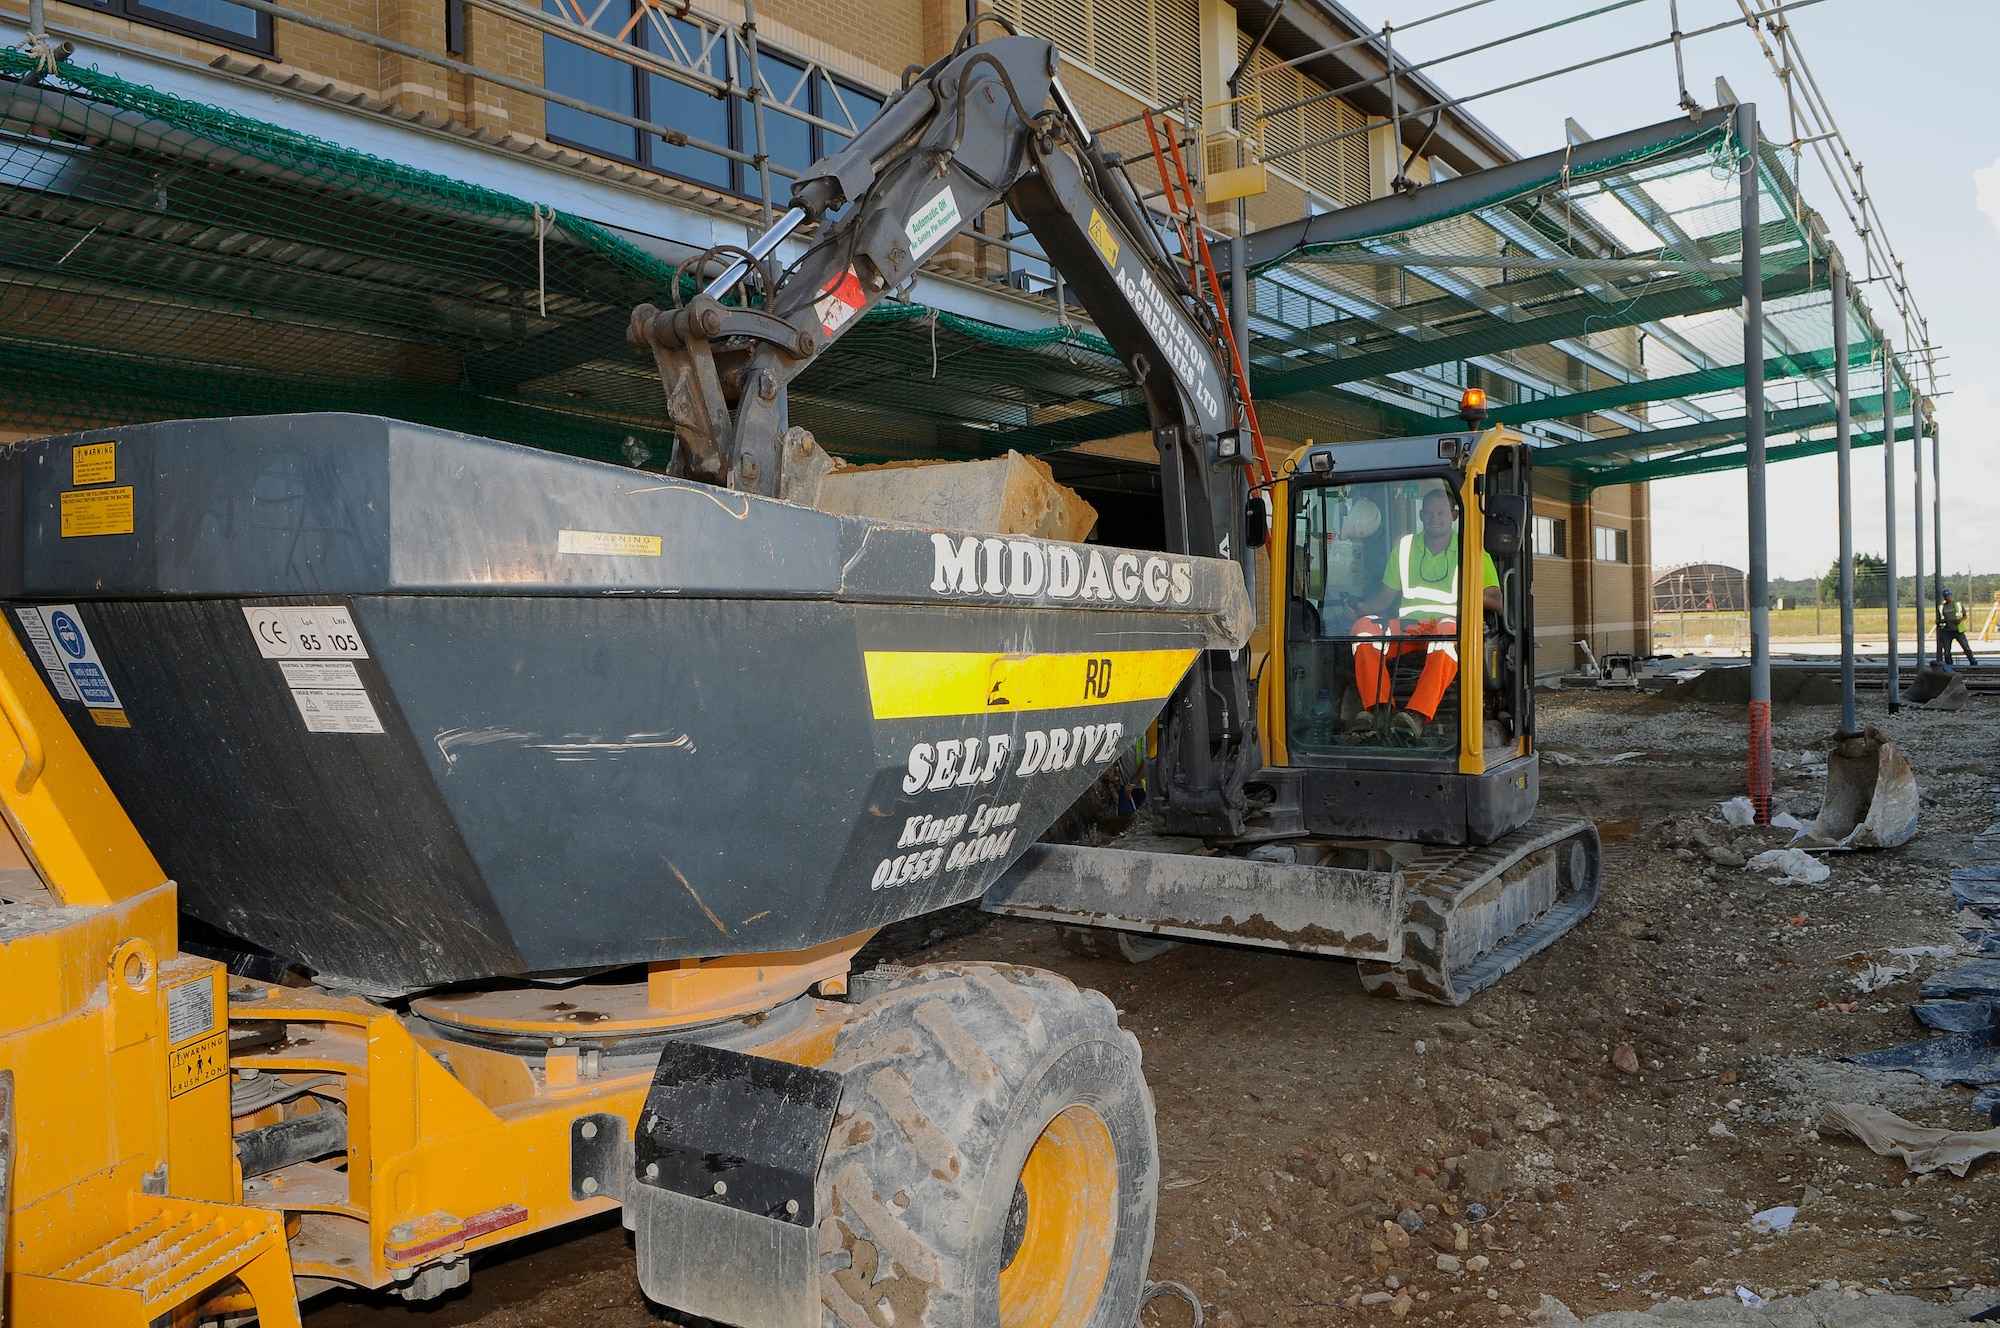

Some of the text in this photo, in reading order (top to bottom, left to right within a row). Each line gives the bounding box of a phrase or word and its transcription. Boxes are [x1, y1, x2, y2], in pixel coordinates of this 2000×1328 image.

[911, 206, 956, 249] No Safety Pin Required
[912, 198, 947, 234] Automatic QH
[1139, 267, 1208, 377] MIDDLETON
[1115, 266, 1218, 420] AGGREGATES LTD
[84, 446, 113, 456] WARNING
[593, 534, 651, 543] WARNING
[930, 533, 1193, 605] MIDDAGGS
[259, 621, 287, 644] CE
[300, 634, 358, 651] 85 105
[77, 678, 92, 686] LOADS
[89, 678, 100, 686] USE
[97, 678, 108, 686] EYE
[84, 668, 99, 677] LOOSE
[1084, 659, 1112, 700] RD
[902, 722, 1124, 796] SELF DRIVE
[897, 802, 1022, 849] Kings Lynn
[871, 847, 944, 891] 01553
[183, 1038, 223, 1060] WARNING
[172, 1064, 227, 1092] CRUSH ZONE
